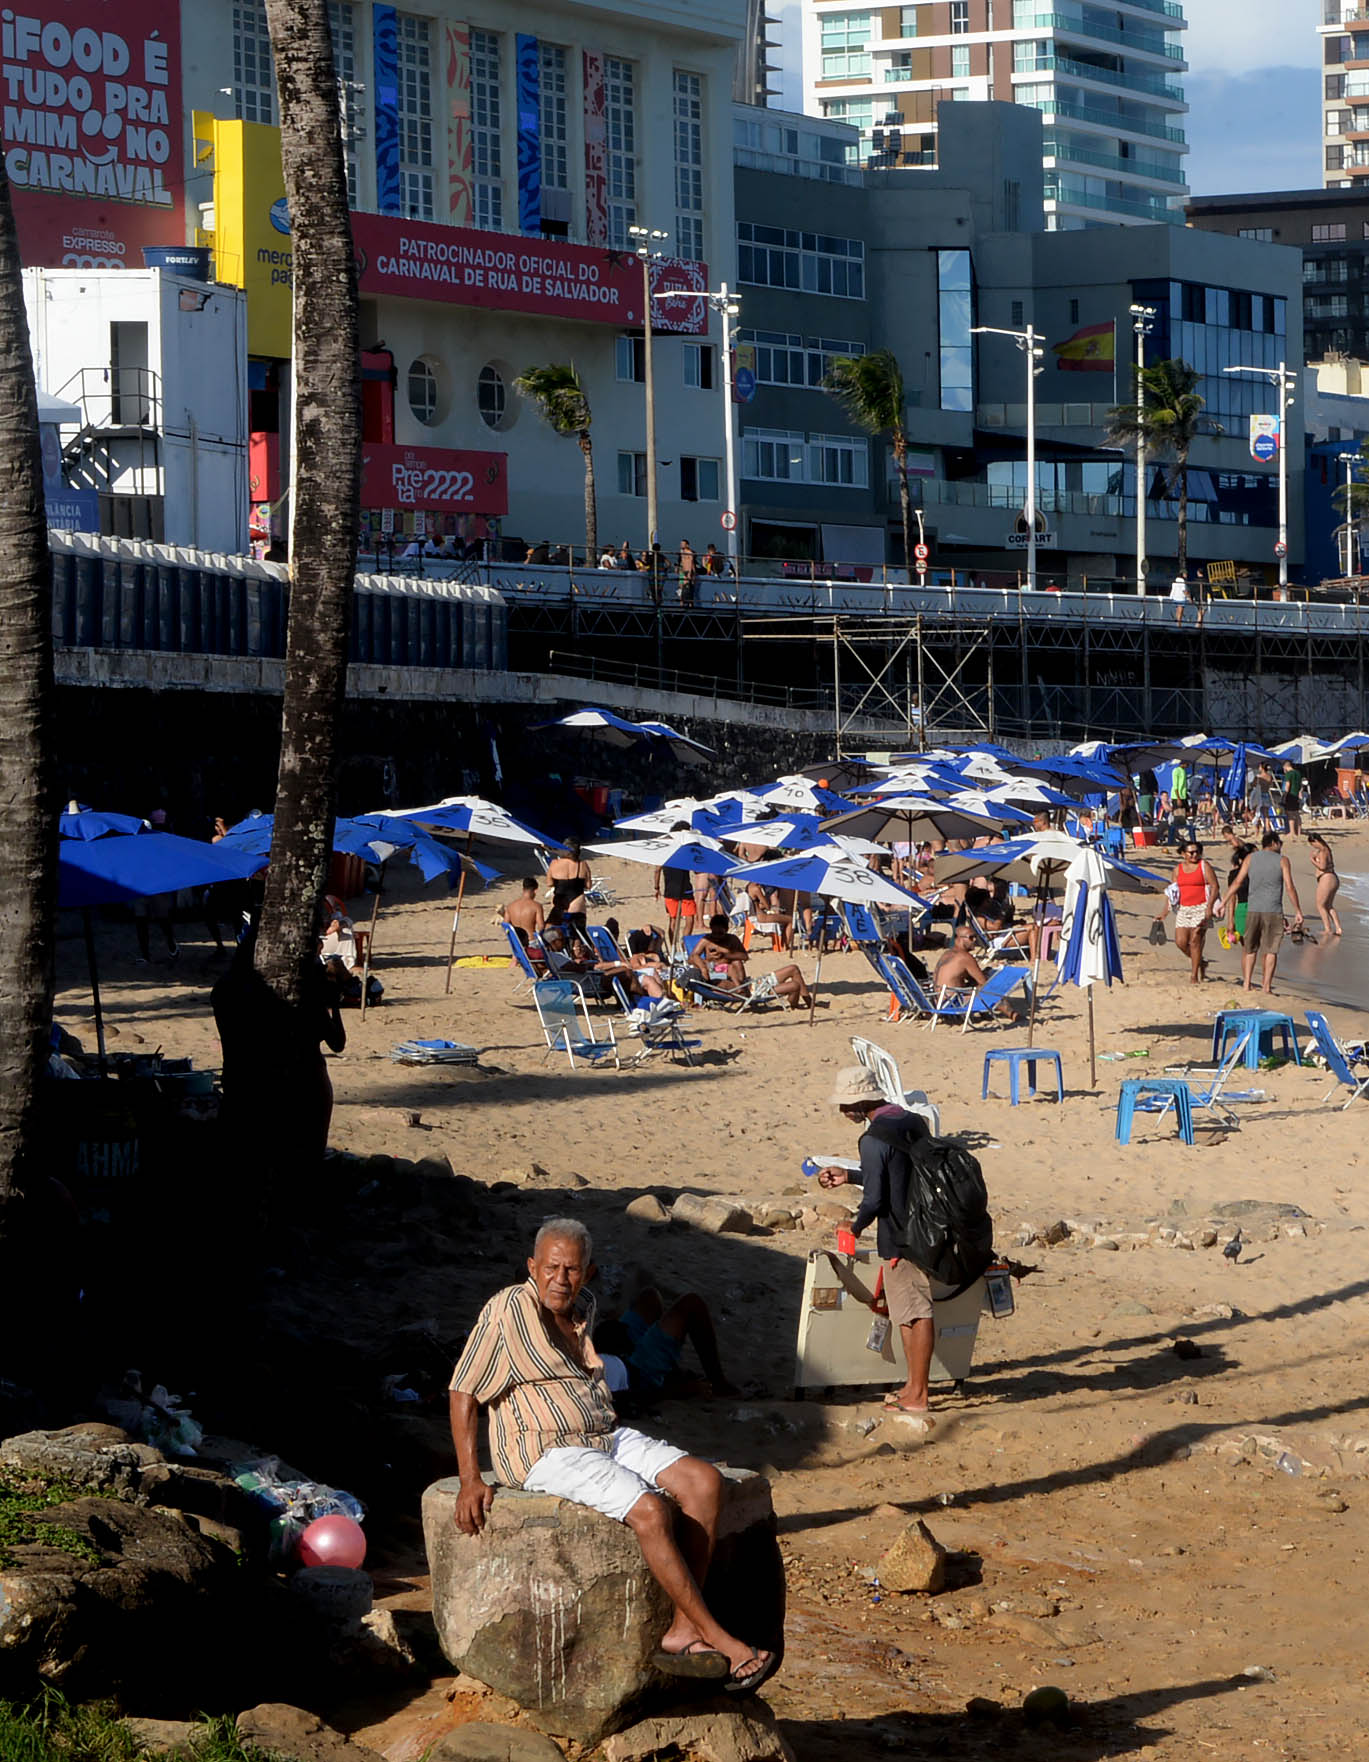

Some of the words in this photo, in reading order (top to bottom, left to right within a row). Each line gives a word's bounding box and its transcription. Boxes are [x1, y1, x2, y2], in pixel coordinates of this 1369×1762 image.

[1, 9, 130, 76] iFOOD
[144, 30, 168, 85] É
[3, 64, 92, 112] TUDO
[105, 81, 169, 125] PRA
[4, 106, 77, 150] MIM
[126, 126, 170, 164] NO
[5, 148, 172, 206] CARNAVAL
[63, 235, 126, 255] EXPRESSO
[257, 247, 293, 267] merc
[400, 237, 517, 272] PATROCINADOR
[520, 254, 576, 282] OFICIAL
[578, 263, 599, 283] DO
[377, 255, 460, 286] CARNAVAL
[464, 268, 484, 288] DE
[488, 270, 519, 294] RUA
[522, 275, 541, 296] DE
[545, 280, 619, 306] SALVADOR
[475, 814, 511, 828] 35
[834, 865, 874, 885] 38
